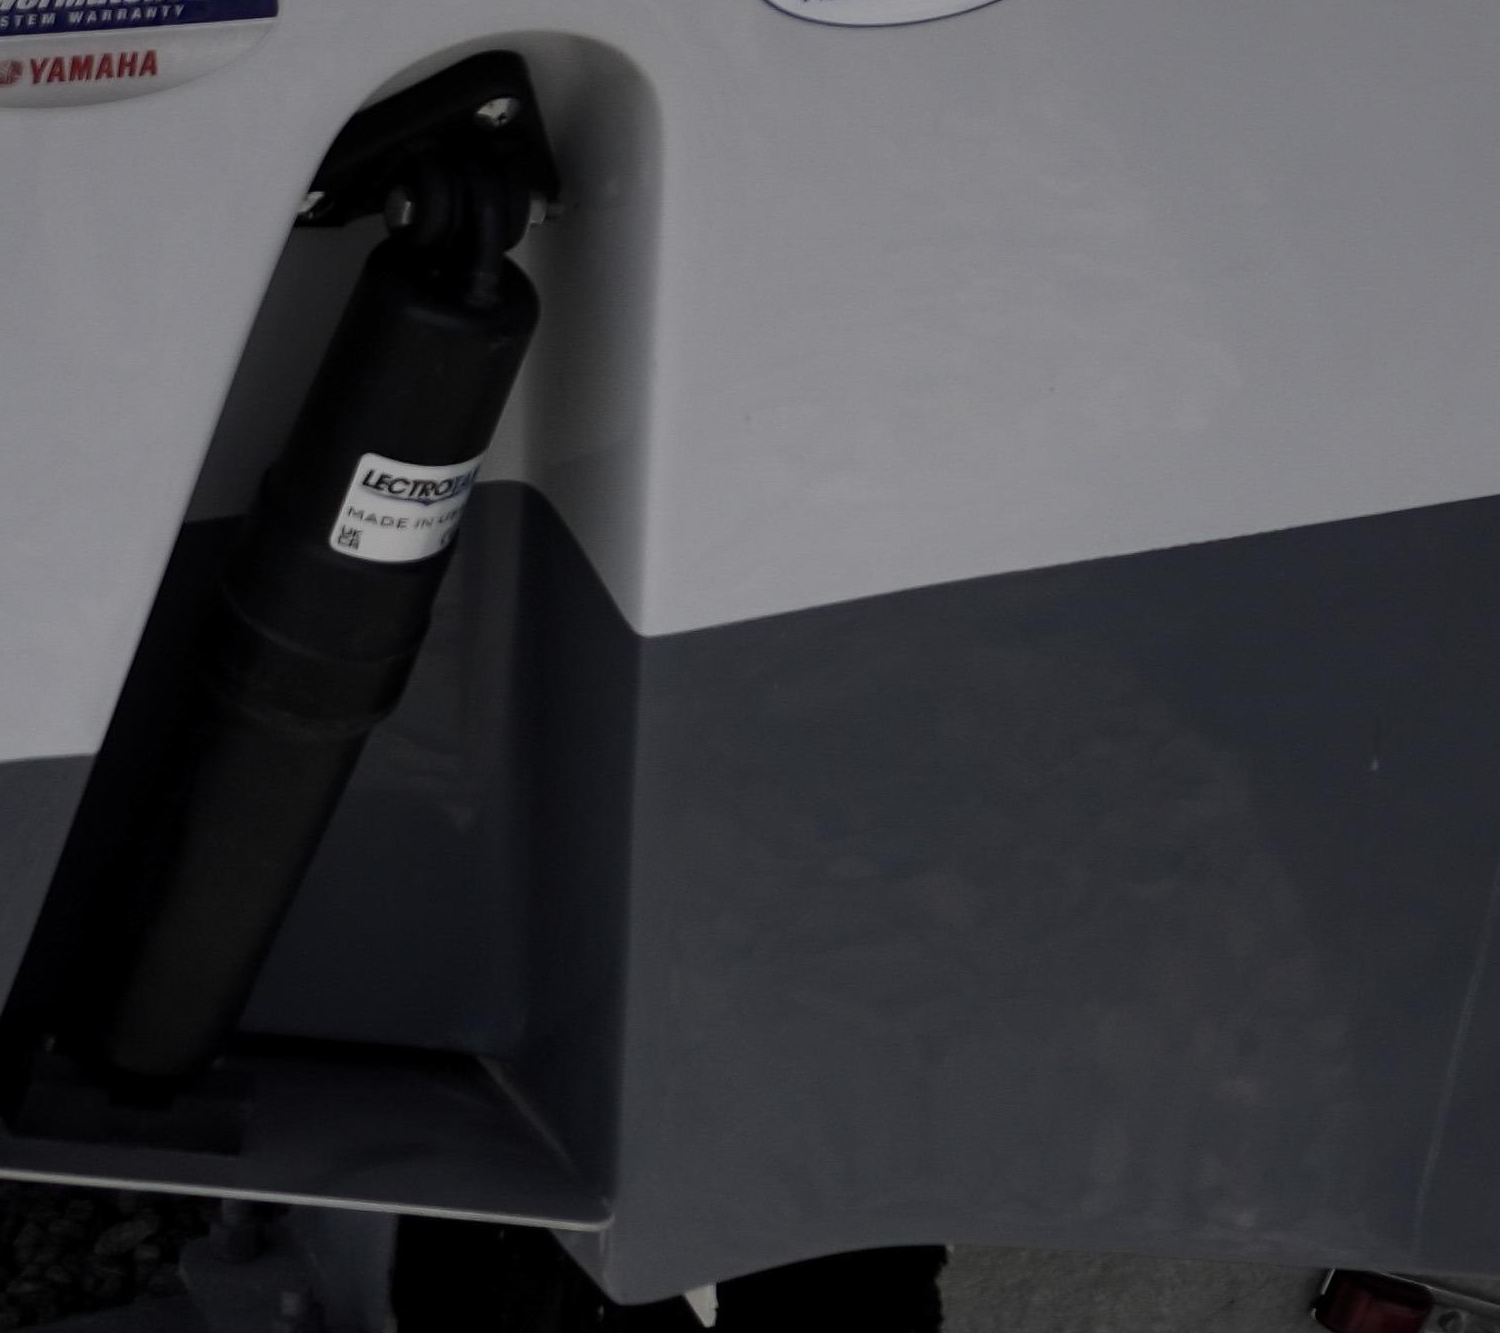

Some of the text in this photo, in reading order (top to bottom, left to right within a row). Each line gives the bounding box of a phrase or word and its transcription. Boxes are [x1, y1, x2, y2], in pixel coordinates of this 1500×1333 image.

[68, 5, 186, 25] WARRANTY
[29, 50, 158, 85] YAMAHA
[348, 505, 409, 529] MADE
[415, 517, 435, 529] IN
